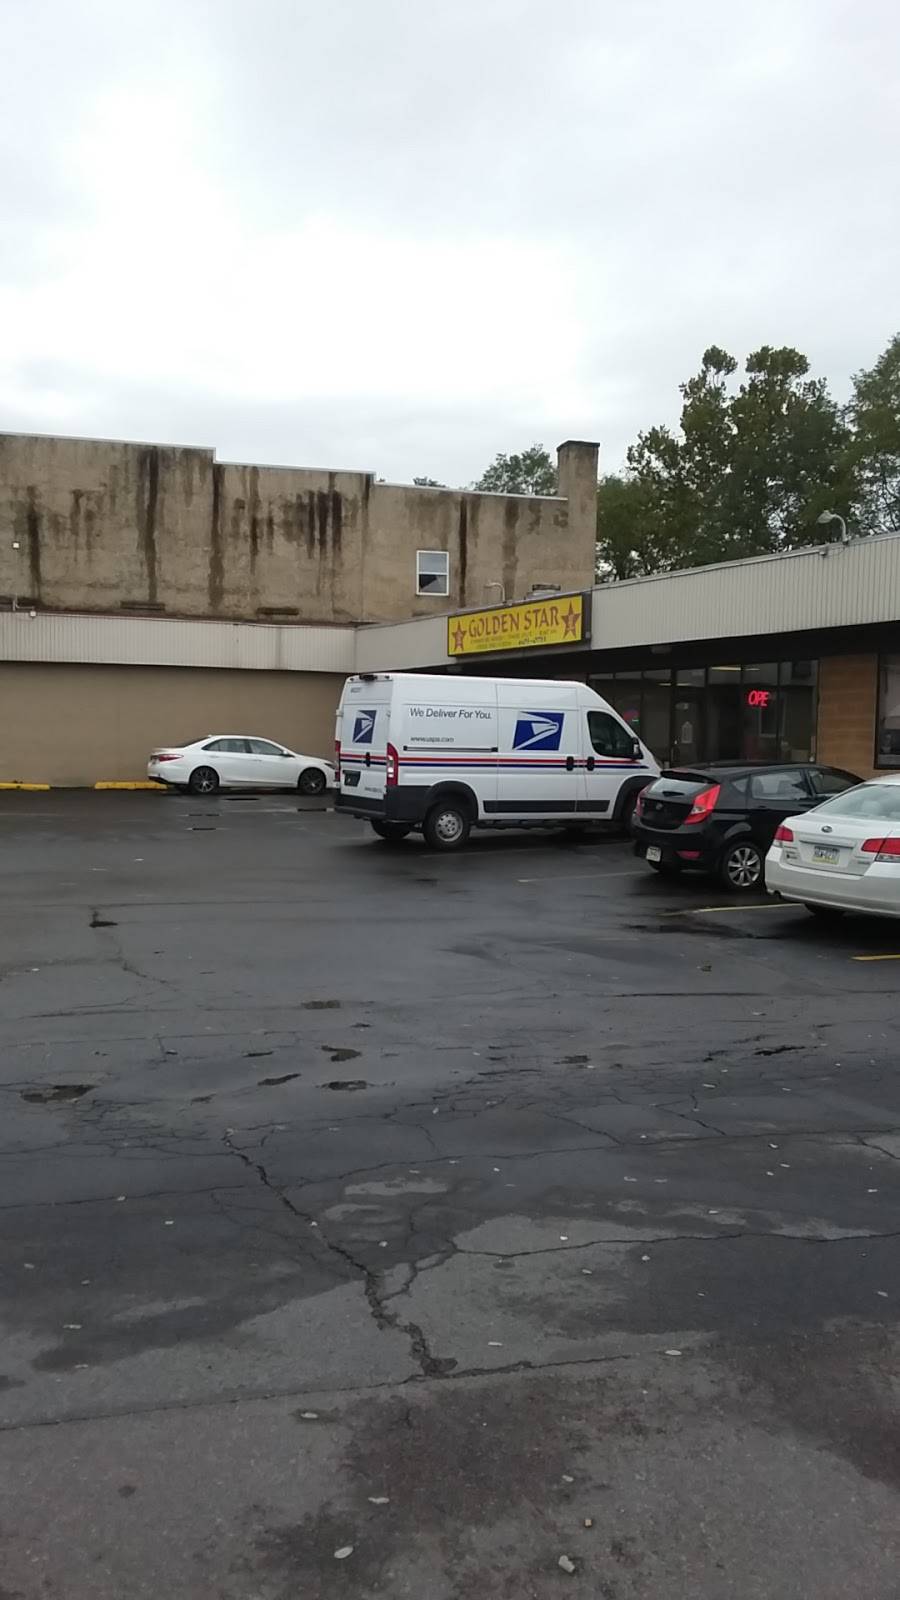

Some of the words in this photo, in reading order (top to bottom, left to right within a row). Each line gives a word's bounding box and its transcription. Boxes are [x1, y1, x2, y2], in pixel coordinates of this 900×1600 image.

[468, 612, 520, 638] GOLDEN
[524, 606, 560, 630] STAR
[410, 708, 424, 717] We
[427, 708, 457, 718] Deliver
[459, 710, 474, 719] For
